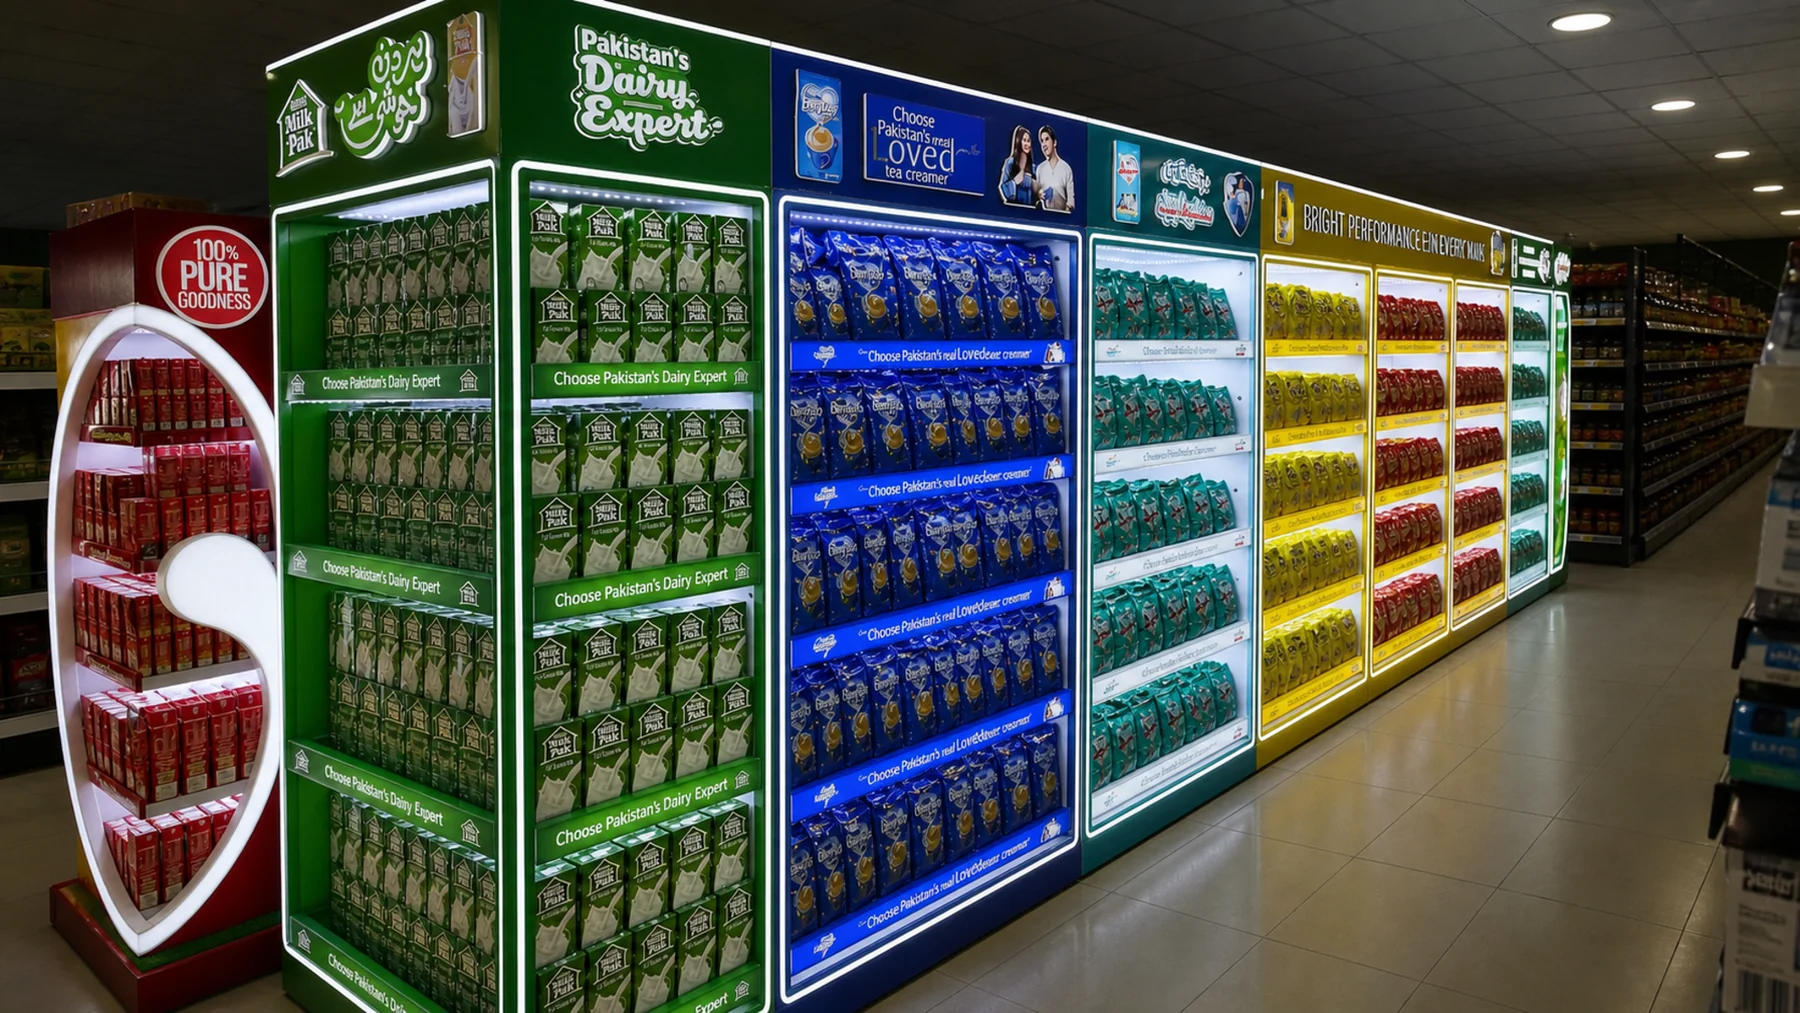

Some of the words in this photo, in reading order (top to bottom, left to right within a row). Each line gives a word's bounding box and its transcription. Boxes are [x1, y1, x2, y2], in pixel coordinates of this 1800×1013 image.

[581, 28, 690, 71] Pakistan's
[580, 54, 697, 110] Dairy
[285, 109, 313, 133] Milk
[581, 94, 712, 145] Expert
[893, 105, 935, 129] Choose
[287, 130, 314, 156] Pak
[878, 119, 930, 144] Pakistan's
[872, 126, 954, 172] Loved
[885, 165, 903, 178] tea
[906, 168, 949, 186] creamer
[1304, 204, 1345, 237] BRIGHT
[1349, 214, 1420, 251] PERFORMANCE
[193, 238, 239, 261] 100%
[180, 260, 249, 292] PURE
[178, 291, 251, 310] GOODNESS
[868, 350, 900, 363] Choose
[322, 376, 348, 390] Choose
[350, 375, 387, 390] Pakistan's
[388, 375, 410, 391] Dairy
[412, 374, 441, 391] Expert
[553, 371, 600, 386] Choose
[603, 370, 659, 385] Pakistan's
[663, 370, 691, 386] Dairy
[694, 370, 727, 386] Expert
[868, 481, 900, 498] Choose
[323, 559, 349, 577] Choose
[350, 565, 387, 584] Pakistan's
[388, 573, 410, 592] Dairy
[412, 576, 441, 595] Expert
[555, 587, 601, 608] Choose
[605, 578, 661, 600] Pakistan's
[663, 574, 692, 590] Dairy
[695, 567, 728, 586] Expert
[868, 622, 900, 642] Choose
[867, 760, 900, 785] Choose
[390, 791, 413, 816] Dairy
[556, 821, 602, 846] Choose
[605, 801, 661, 830] Pakistan's
[663, 790, 692, 812] Dairy
[695, 778, 728, 800] Expert
[867, 904, 899, 930] Choose
